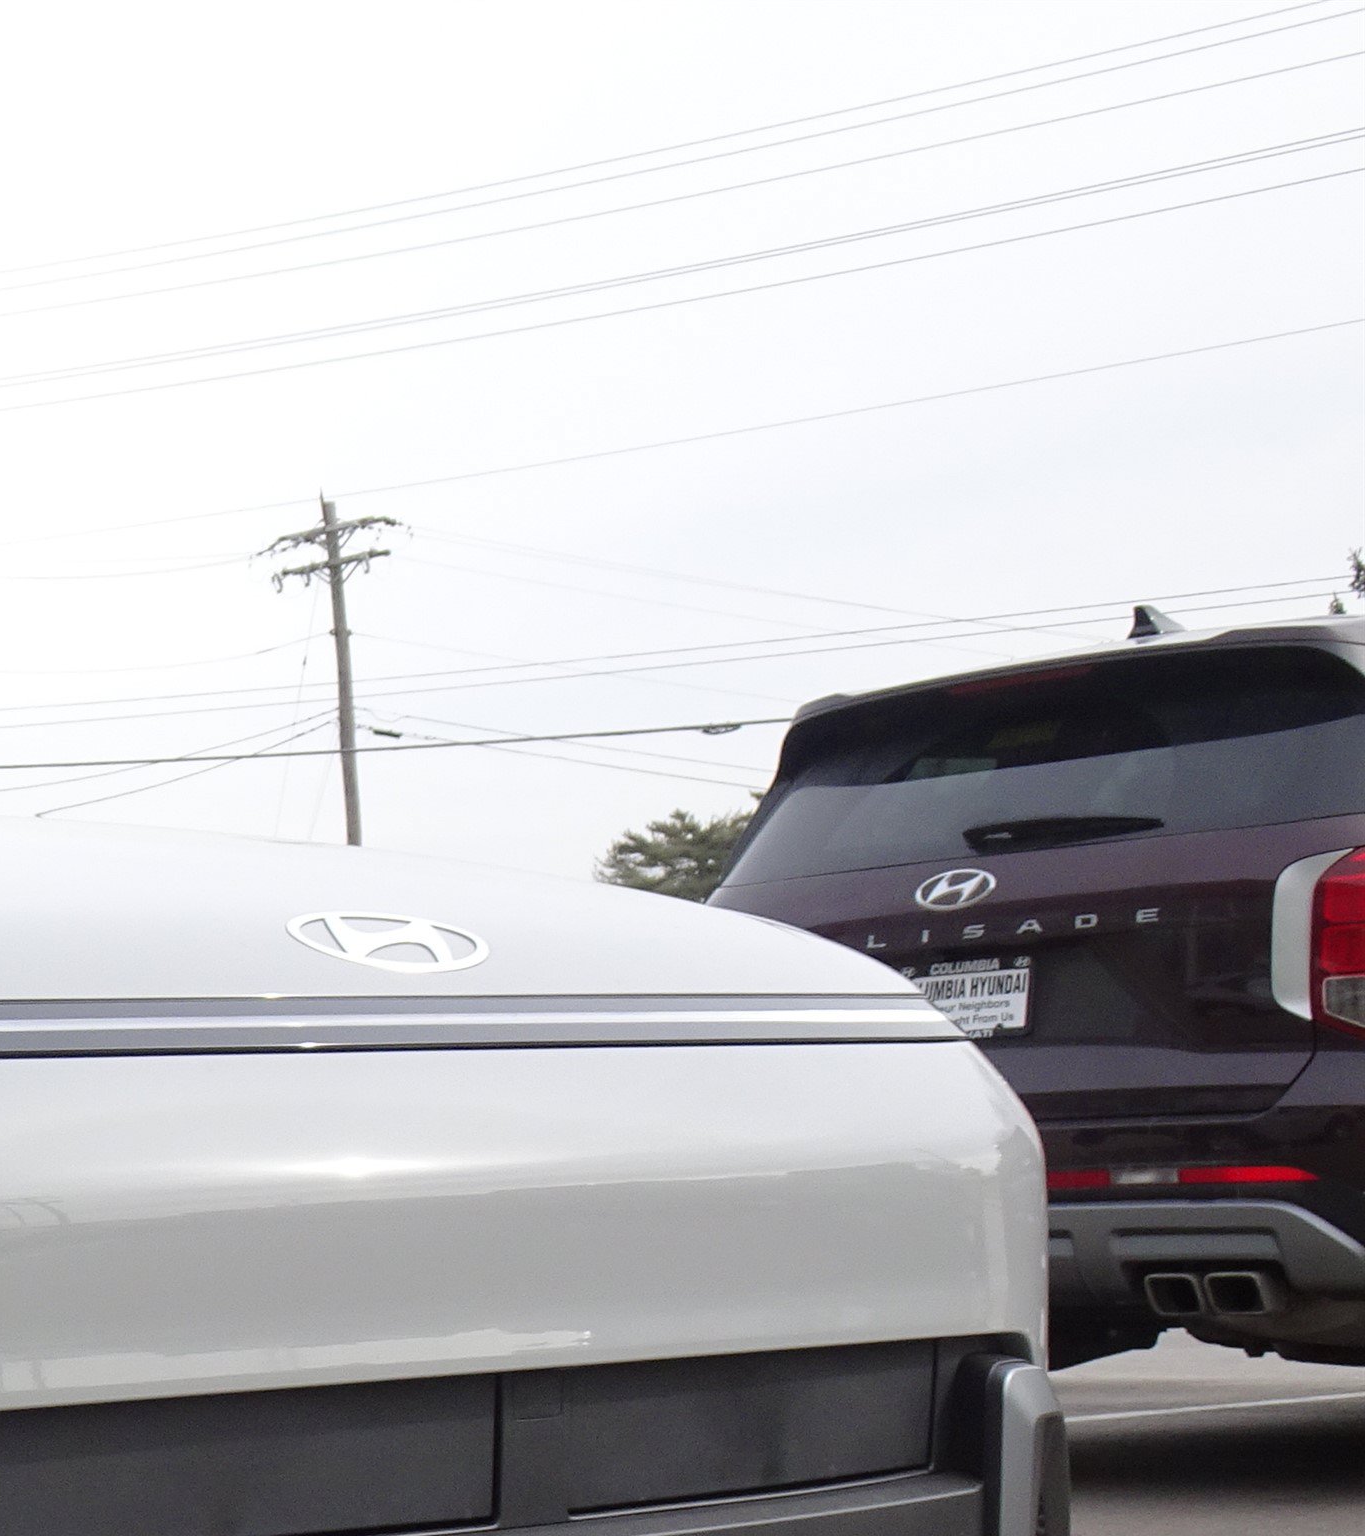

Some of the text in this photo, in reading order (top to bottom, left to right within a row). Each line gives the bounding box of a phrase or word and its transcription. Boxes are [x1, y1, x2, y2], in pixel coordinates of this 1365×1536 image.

[867, 908, 1160, 949] LISADE
[930, 958, 1000, 975] COLUMBIA
[970, 973, 1027, 998] HYUNDAI
[959, 1000, 1010, 1012] Neighbors
[973, 1014, 998, 1023] From
[1001, 1013, 1014, 1022] Us
